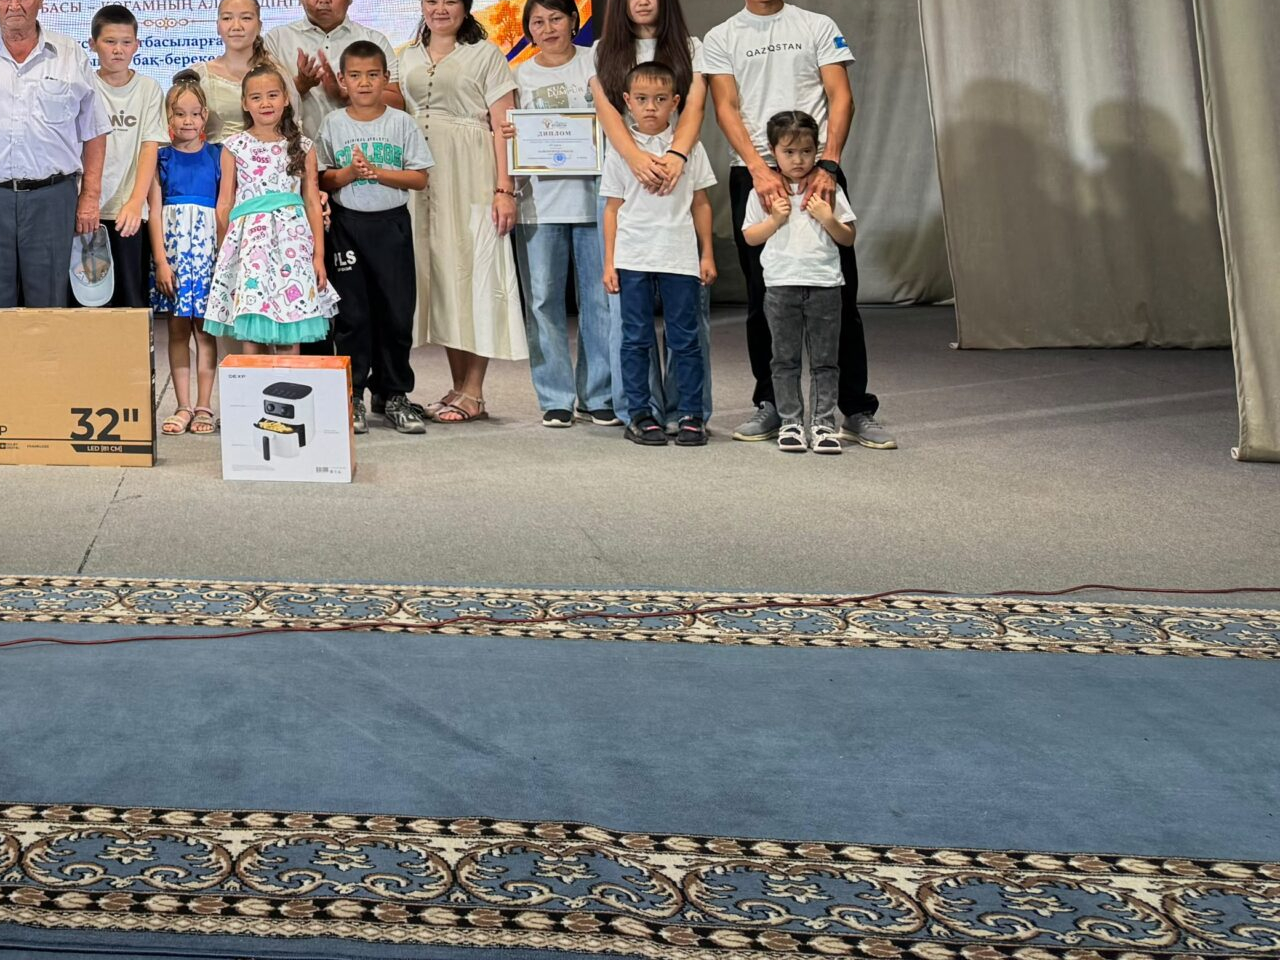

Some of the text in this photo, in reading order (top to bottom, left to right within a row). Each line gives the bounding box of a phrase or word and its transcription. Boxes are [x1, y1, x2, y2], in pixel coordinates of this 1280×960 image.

[41, 2, 81, 13] БАСЫ
[138, 36, 224, 49] тбасыларға
[746, 43, 802, 57] QAZQSTAN
[537, 130, 572, 138] ДИПЛОМ
[336, 142, 403, 169] COLEGE
[70, 407, 139, 441] 32"
